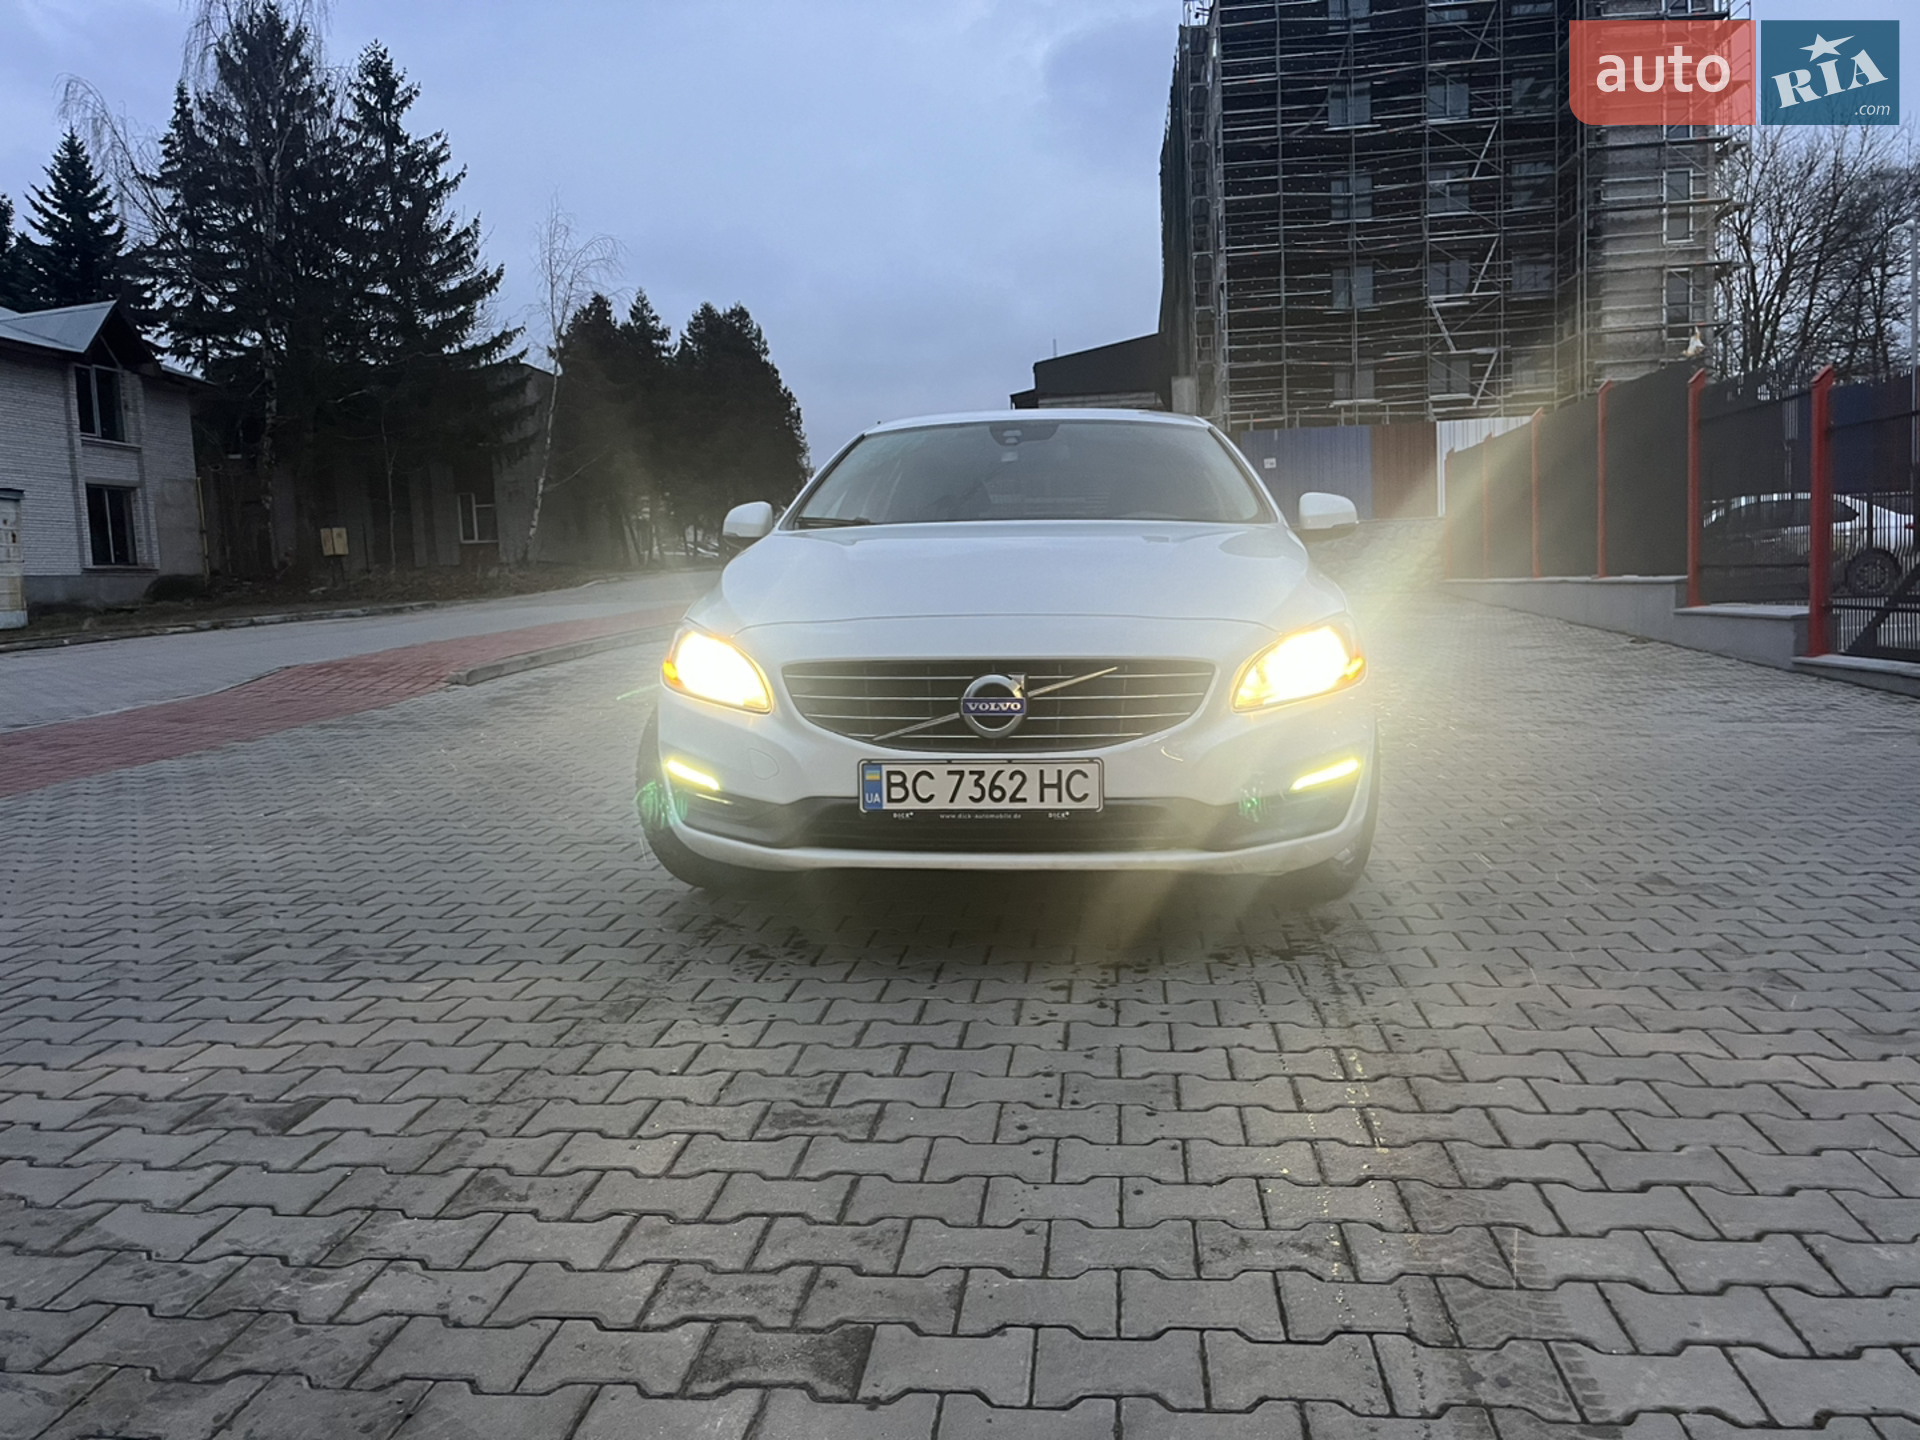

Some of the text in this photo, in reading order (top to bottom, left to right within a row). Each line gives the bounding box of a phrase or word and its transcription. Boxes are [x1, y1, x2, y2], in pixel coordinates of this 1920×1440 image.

[966, 702, 1021, 711] VOLVO
[886, 769, 1090, 804] BC 7362 HC
[865, 793, 881, 804] UA
